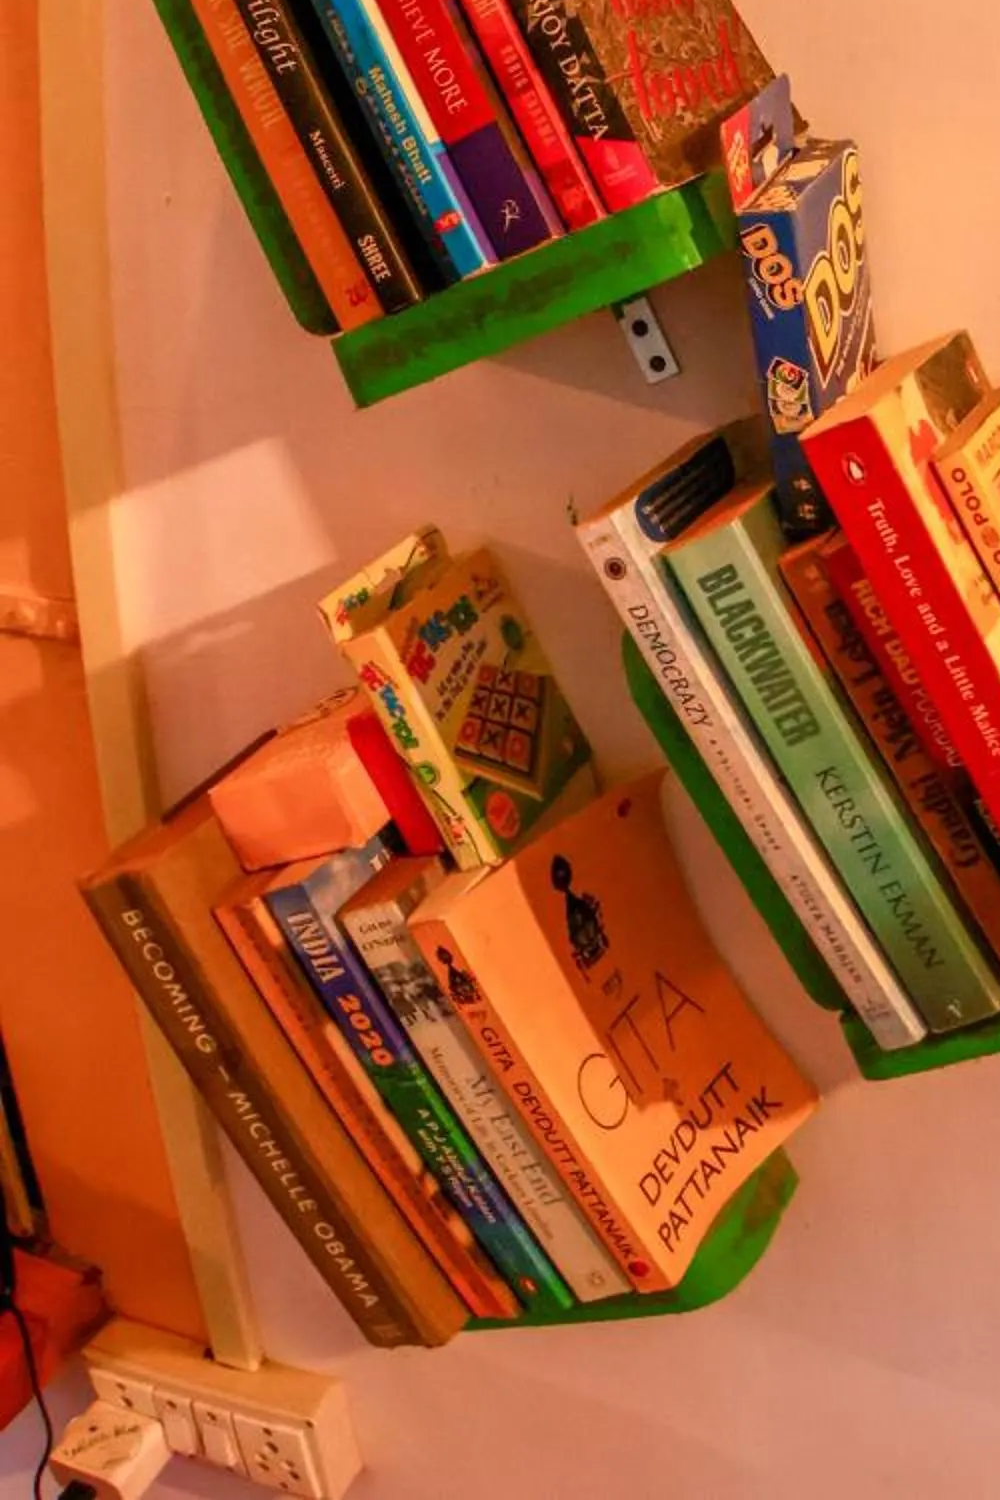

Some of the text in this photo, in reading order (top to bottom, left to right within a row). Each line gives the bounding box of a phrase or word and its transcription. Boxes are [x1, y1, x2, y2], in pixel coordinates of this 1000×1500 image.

[368, 65, 407, 137] Mahesh
[401, 136, 432, 185] Bhatt
[424, 47, 468, 116] MORE
[559, 53, 610, 141] DATTA
[356, 233, 392, 283] SHREE
[739, 222, 806, 311] DOS
[951, 466, 989, 526] POLO
[627, 603, 714, 729] DEMOCRAZY
[867, 498, 896, 554] Truth,
[893, 554, 922, 598] Love
[916, 600, 945, 637] and
[934, 637, 949, 653] a
[943, 653, 974, 703] Little
[697, 563, 821, 748] BLACKWATER
[815, 765, 892, 877] KERSTIN
[879, 879, 946, 971] EKMAN
[287, 910, 346, 984] INDIA
[336, 992, 395, 1068] 2020
[577, 970, 706, 1130] GITA
[121, 909, 216, 1055] BECOMING
[227, 1090, 318, 1215] MICHELLE
[314, 1220, 382, 1310] OBAMA
[480, 1026, 636, 1261] GITA DEVDUTT PATTANAIK
[490, 1113, 524, 1159] East
[521, 1160, 567, 1207] End
[639, 1061, 742, 1208] DEVDUTT
[656, 1086, 785, 1254] PATTANAIK
